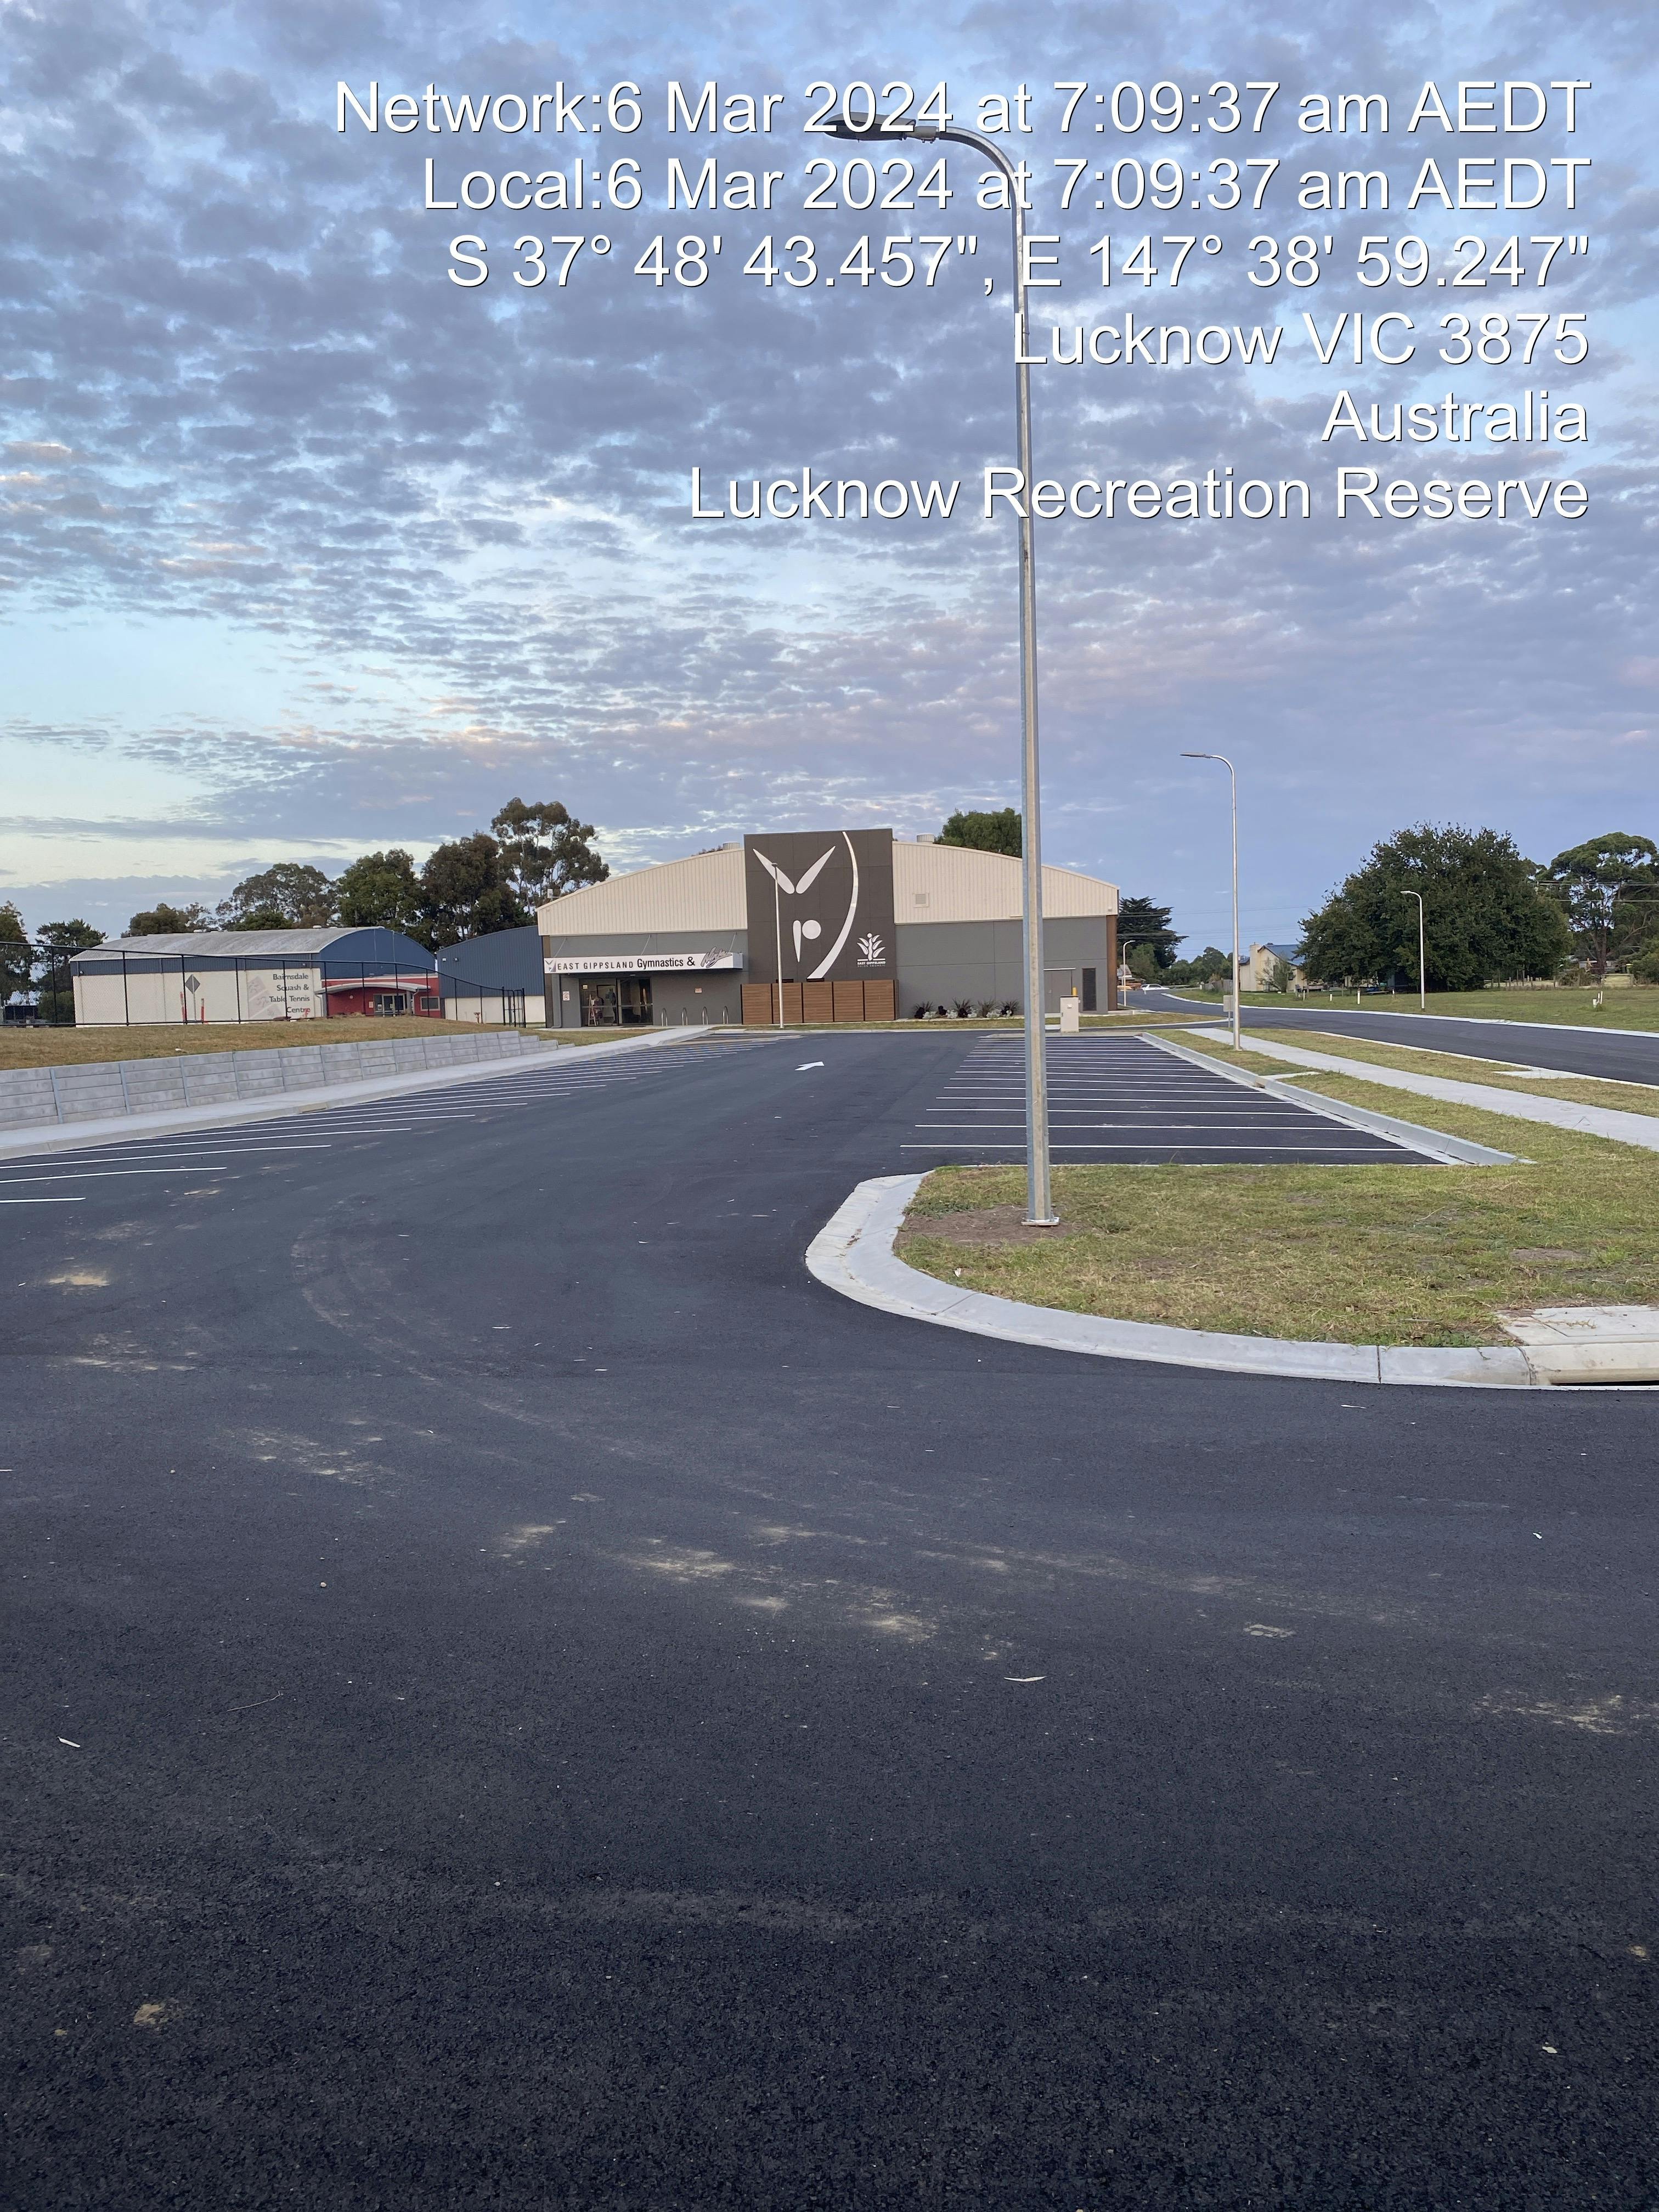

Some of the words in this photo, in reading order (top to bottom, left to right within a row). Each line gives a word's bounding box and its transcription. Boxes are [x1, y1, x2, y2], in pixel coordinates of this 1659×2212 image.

[557, 962, 579, 970] EAST
[583, 961, 633, 969] GIPPSLAND
[637, 957, 684, 970] Gymnastics
[687, 956, 696, 966] &
